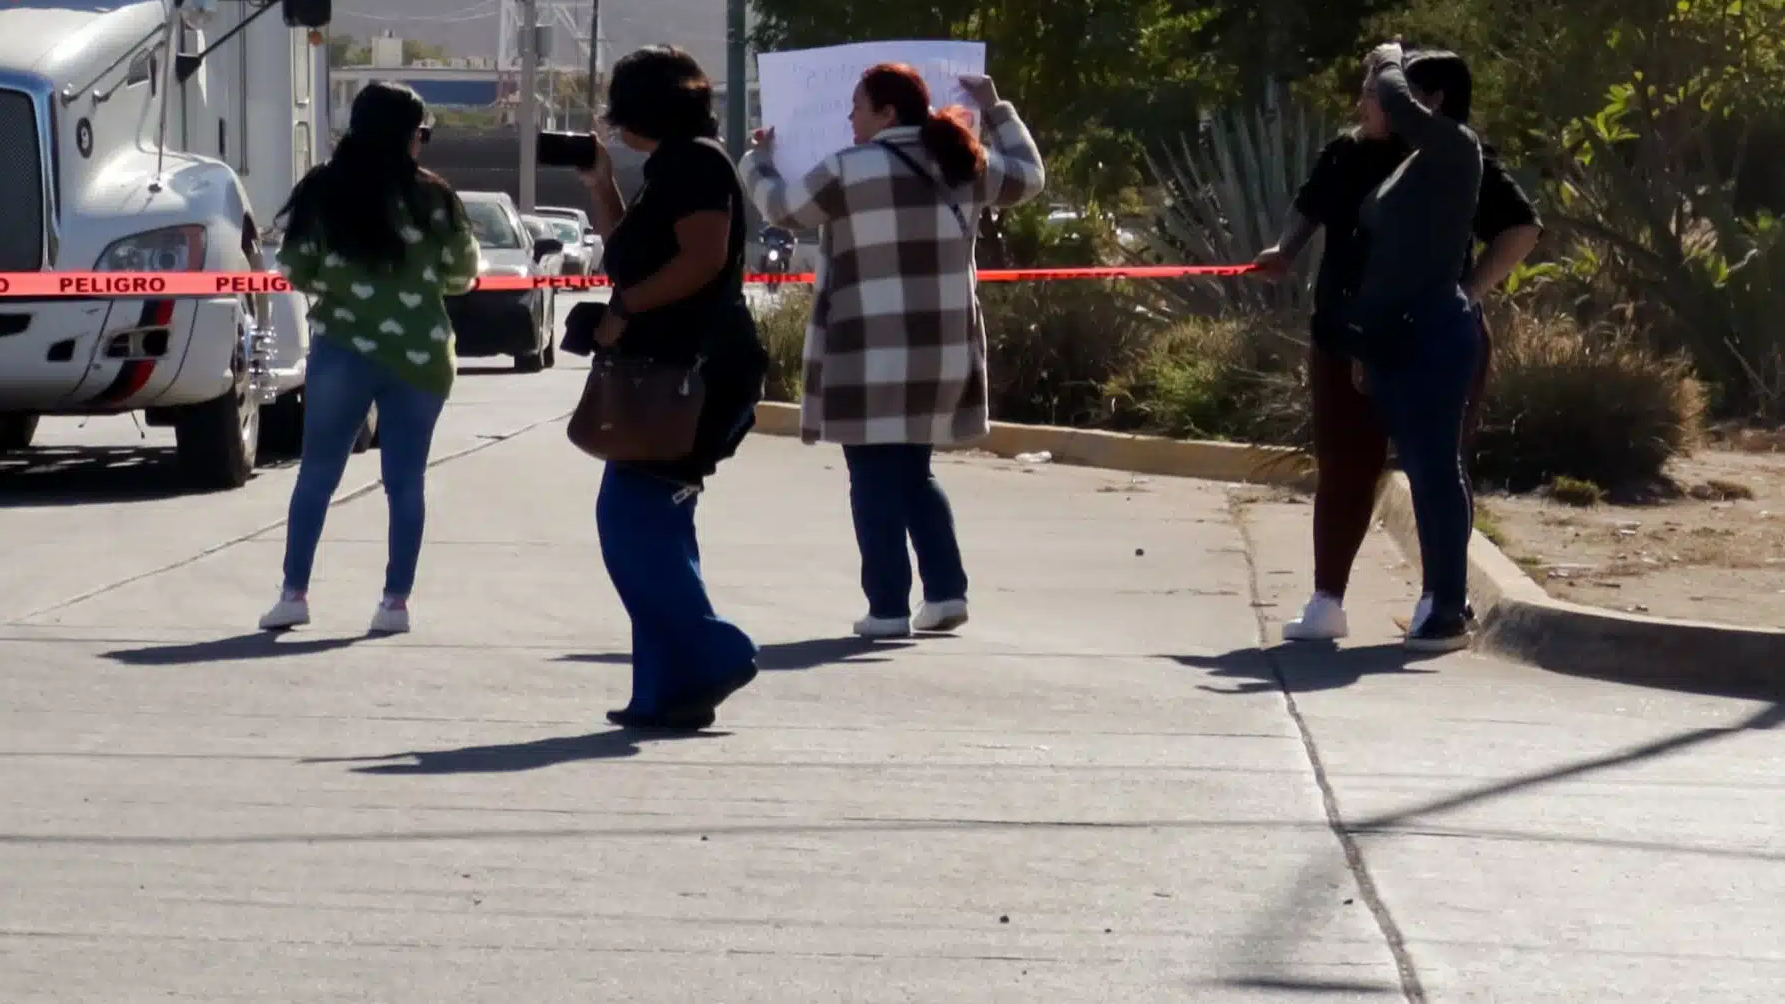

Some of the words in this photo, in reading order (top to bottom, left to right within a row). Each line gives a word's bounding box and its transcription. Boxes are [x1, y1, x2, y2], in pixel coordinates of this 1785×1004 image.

[59, 276, 166, 293] PELIGRO
[215, 276, 295, 292] PELIG
[533, 277, 612, 288] PELIG
